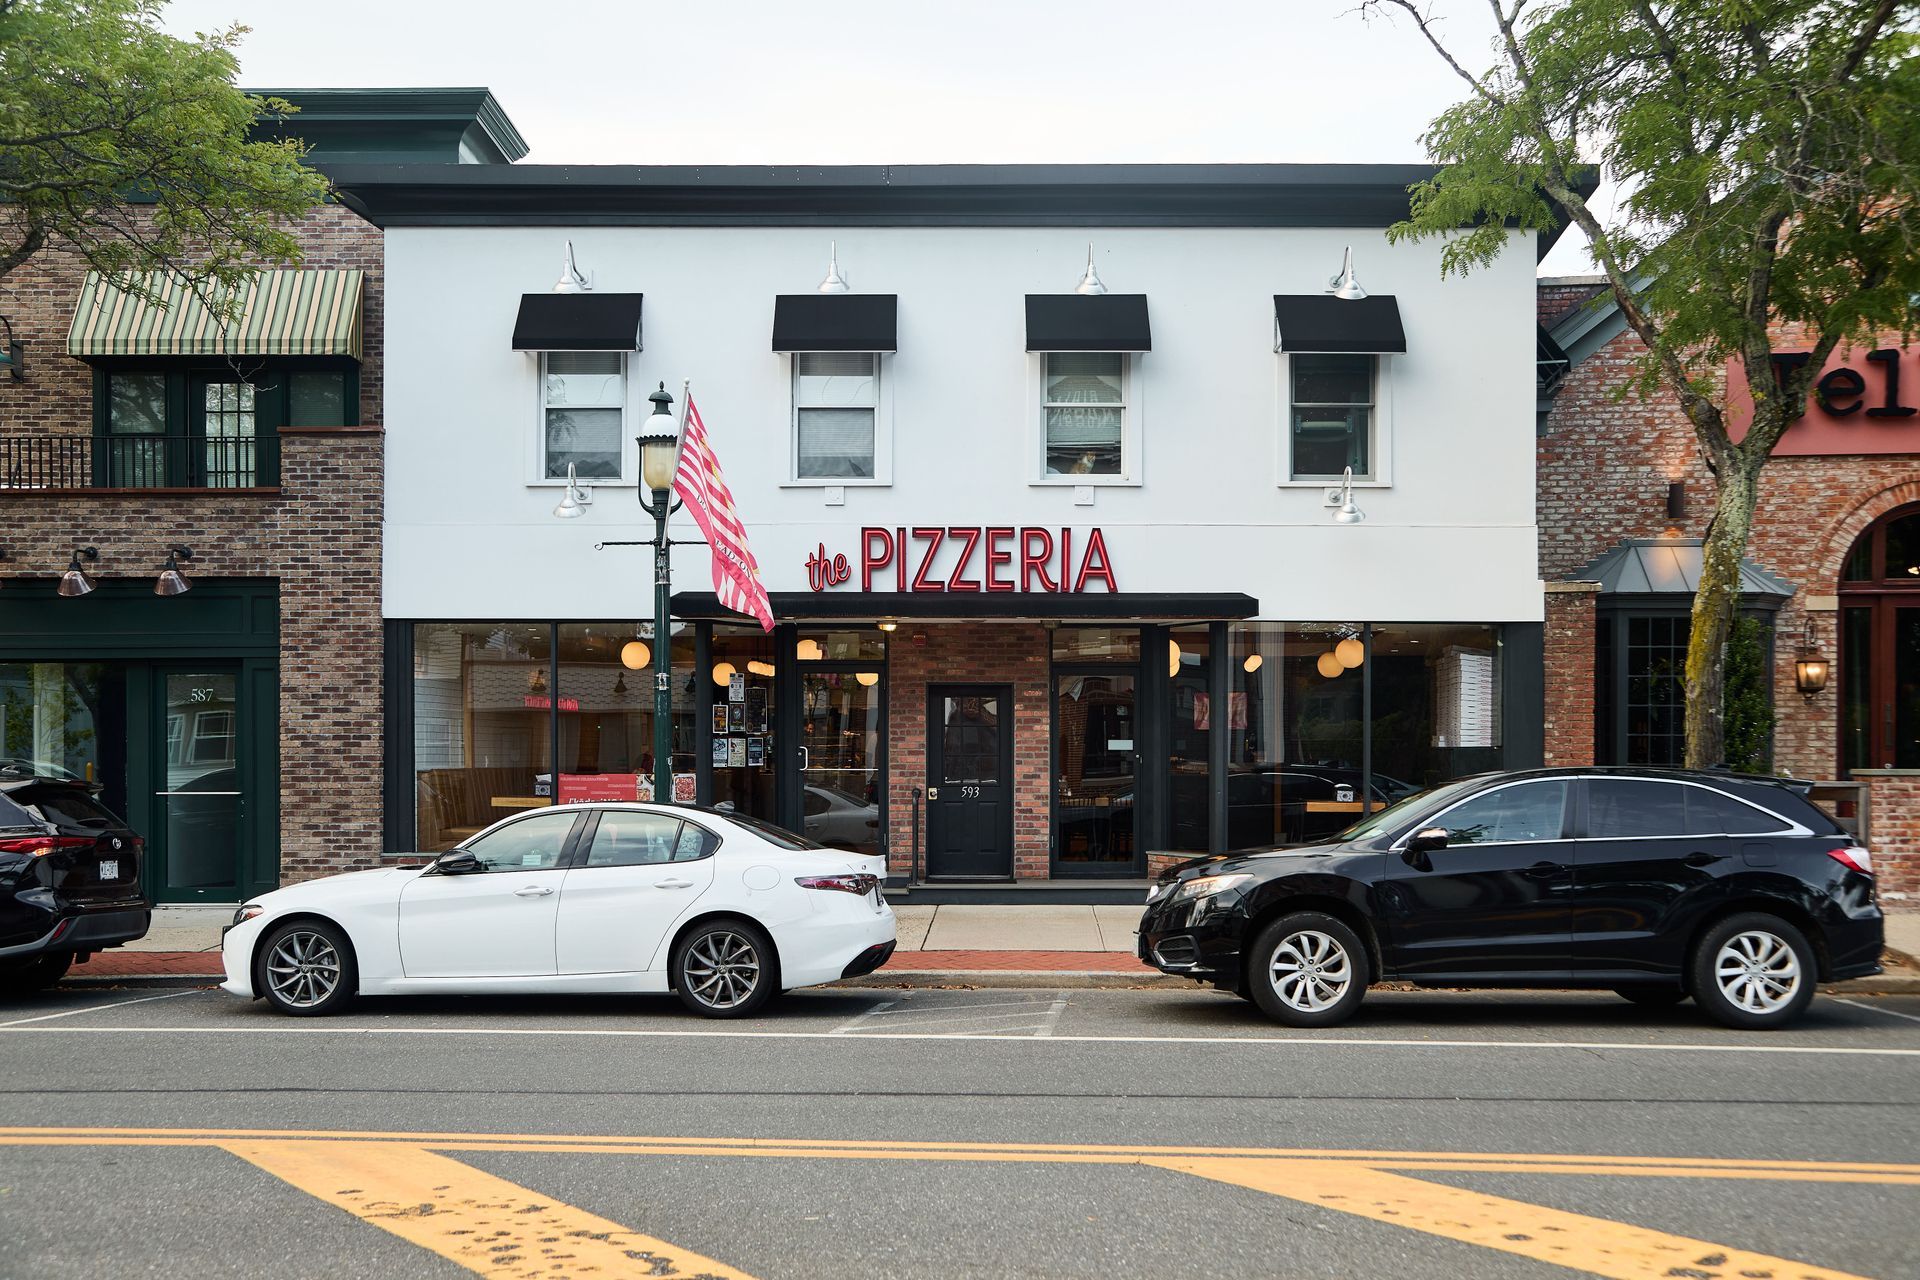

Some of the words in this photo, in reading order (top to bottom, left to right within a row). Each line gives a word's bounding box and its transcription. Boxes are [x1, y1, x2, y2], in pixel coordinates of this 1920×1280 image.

[805, 542, 851, 592] the
[861, 527, 1119, 593] PIZZERIA
[190, 688, 214, 702] 587
[961, 785, 980, 799] 593
